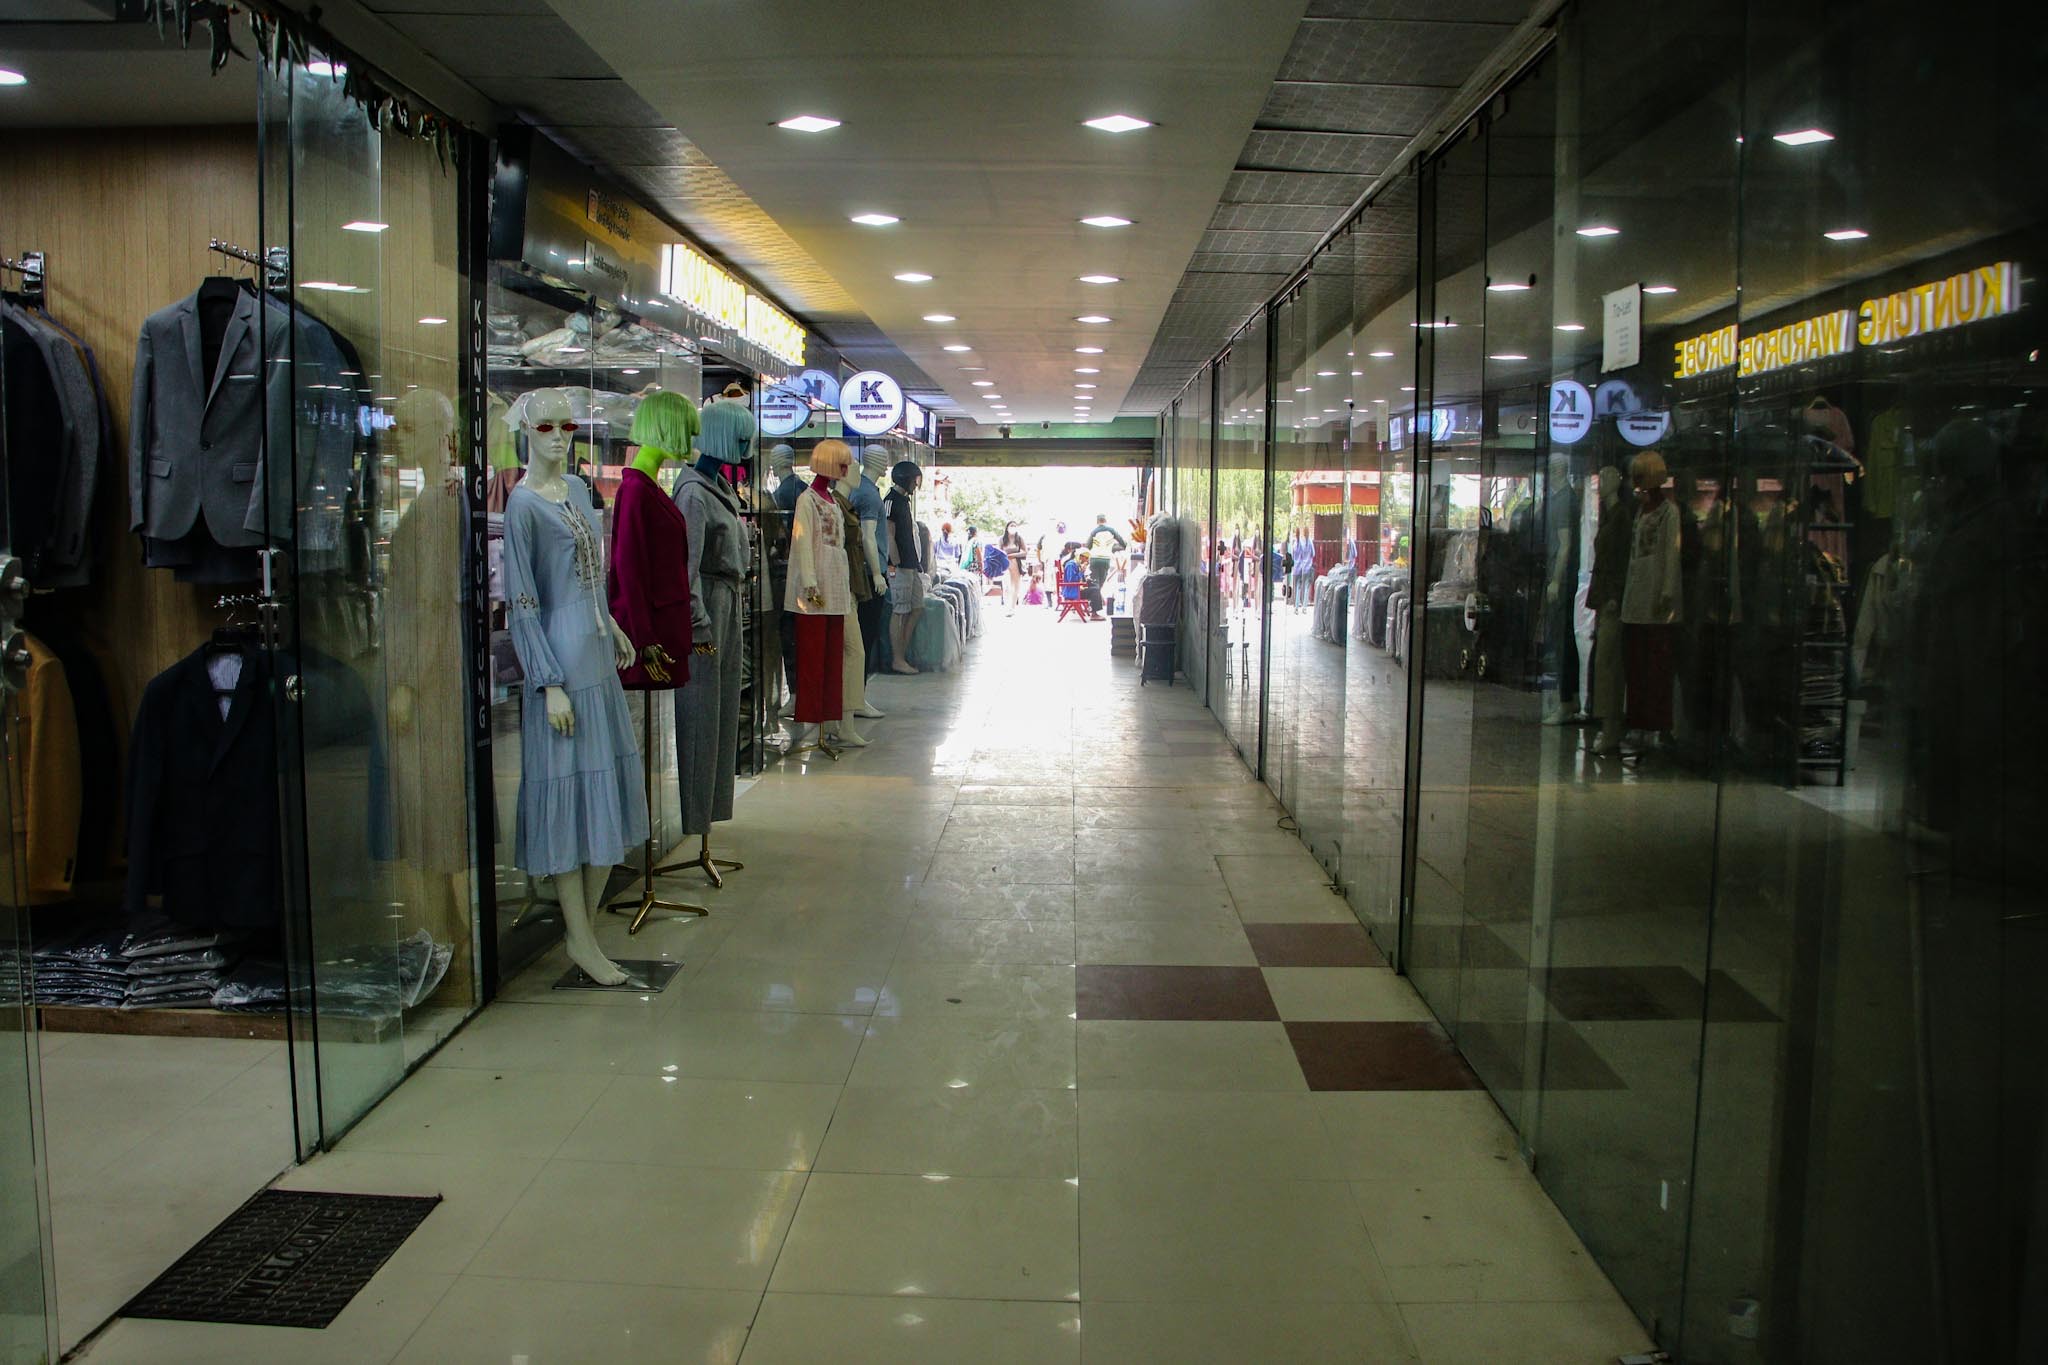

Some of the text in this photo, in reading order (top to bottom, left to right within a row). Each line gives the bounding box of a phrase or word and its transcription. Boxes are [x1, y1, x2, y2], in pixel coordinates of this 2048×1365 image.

[685, 313, 691, 329] A
[742, 343, 766, 367] LADIES
[860, 381, 884, 403] K
[228, 1209, 348, 1301] WELCOME
